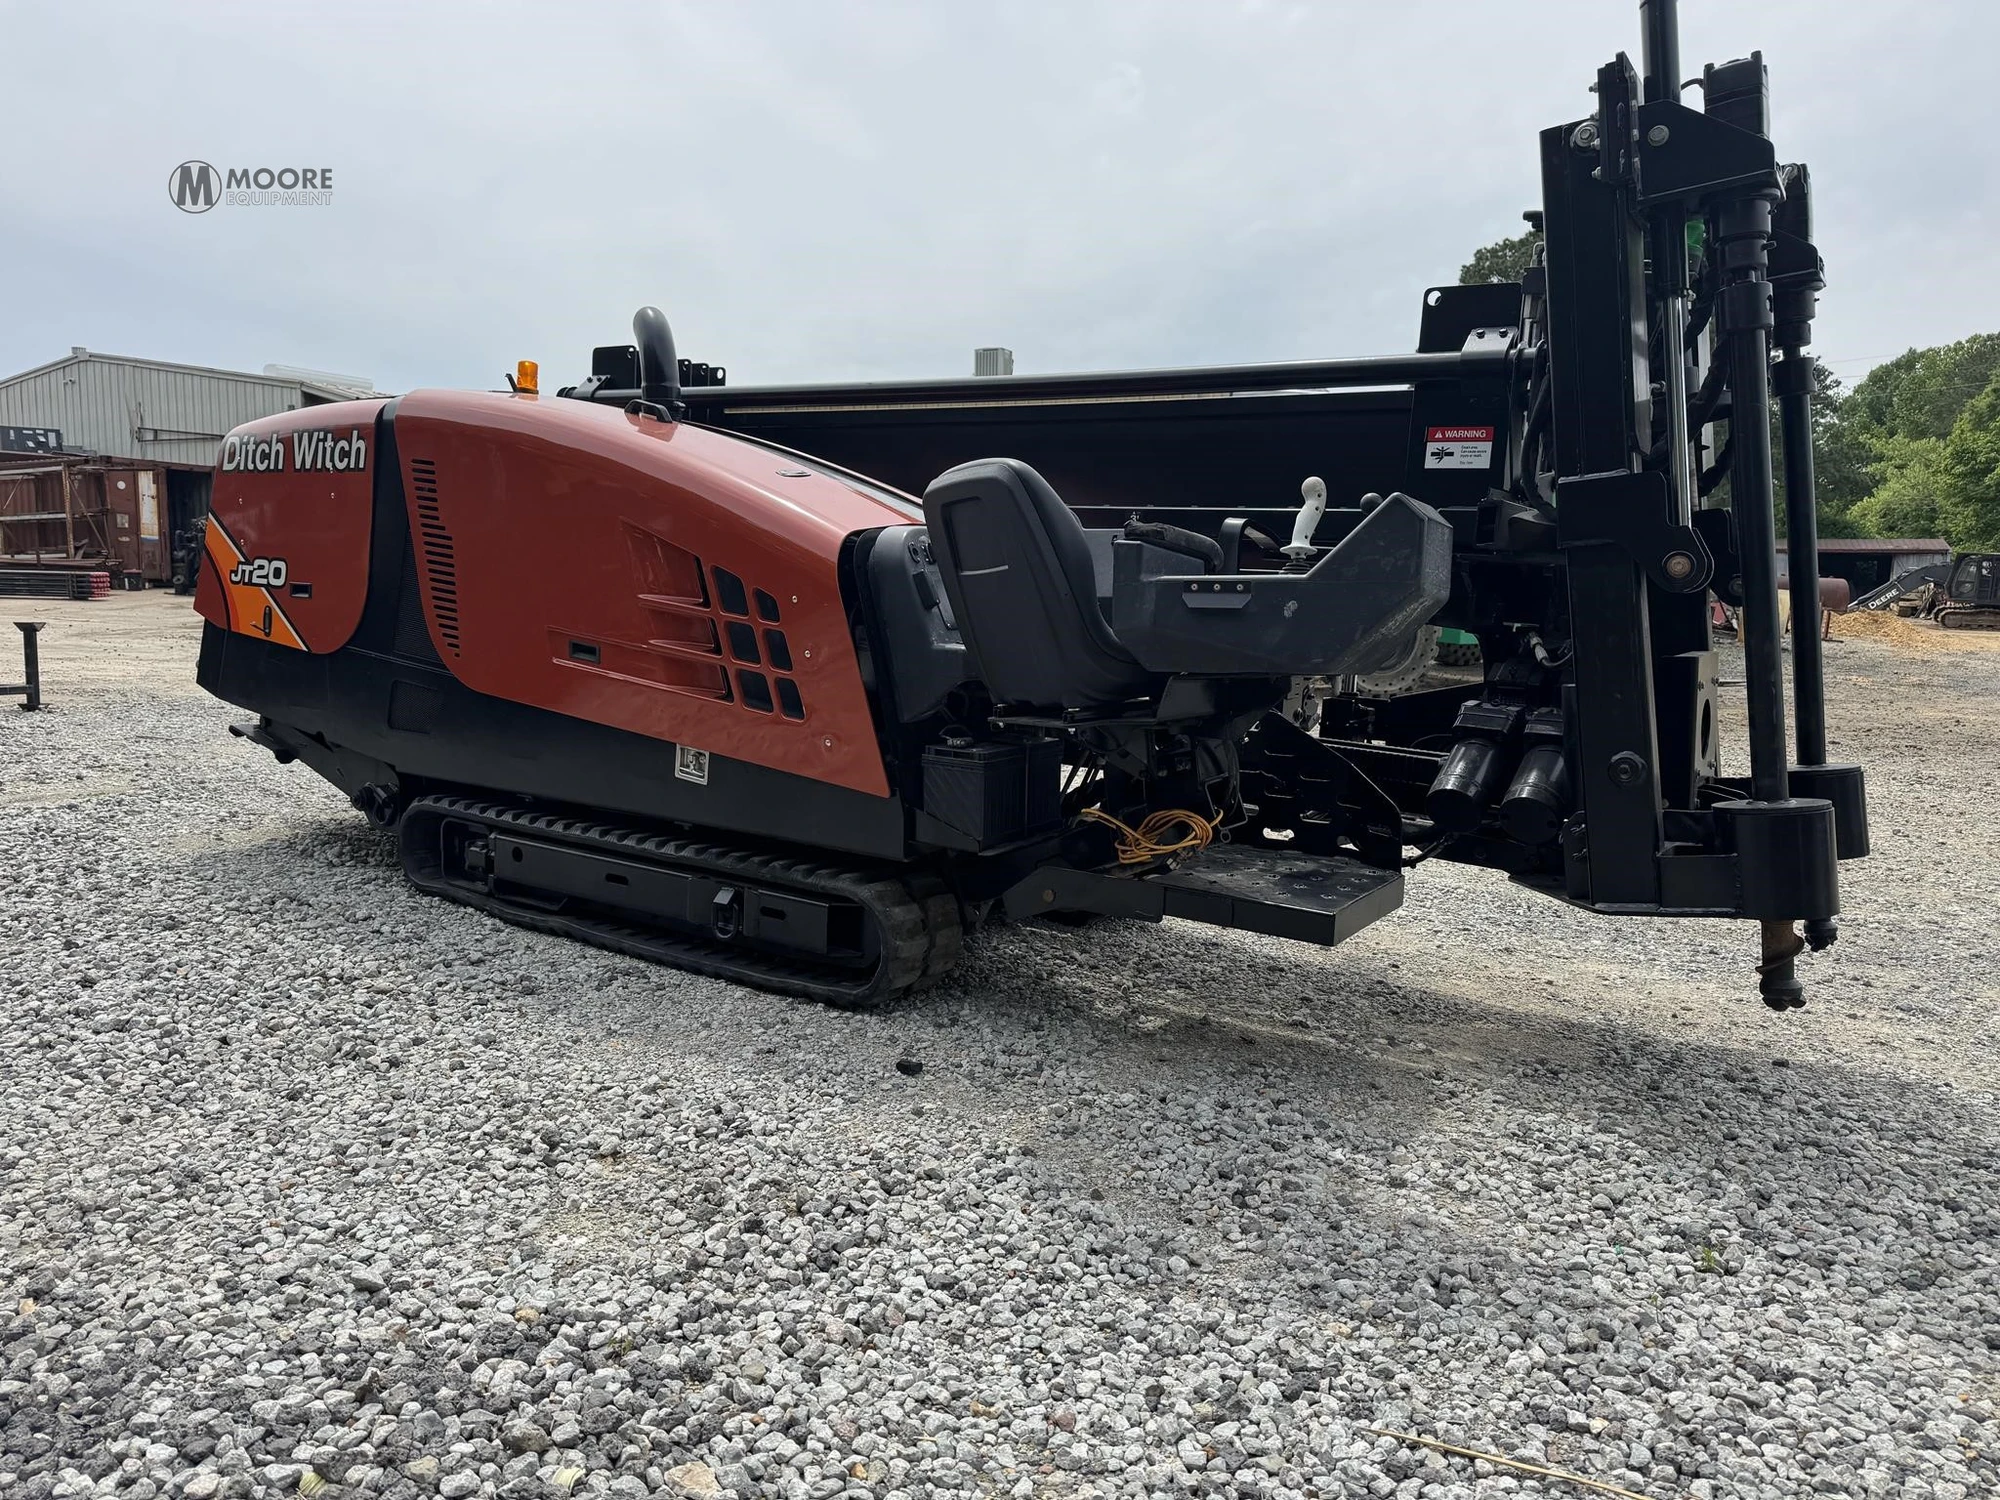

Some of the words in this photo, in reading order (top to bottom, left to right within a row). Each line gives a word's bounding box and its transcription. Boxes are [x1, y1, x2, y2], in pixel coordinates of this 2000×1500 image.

[1444, 430, 1486, 438] WARNING
[222, 434, 284, 472] Ditch
[293, 430, 367, 471] Witch
[230, 558, 288, 587] JT20
[1868, 588, 1899, 609] DEERE
